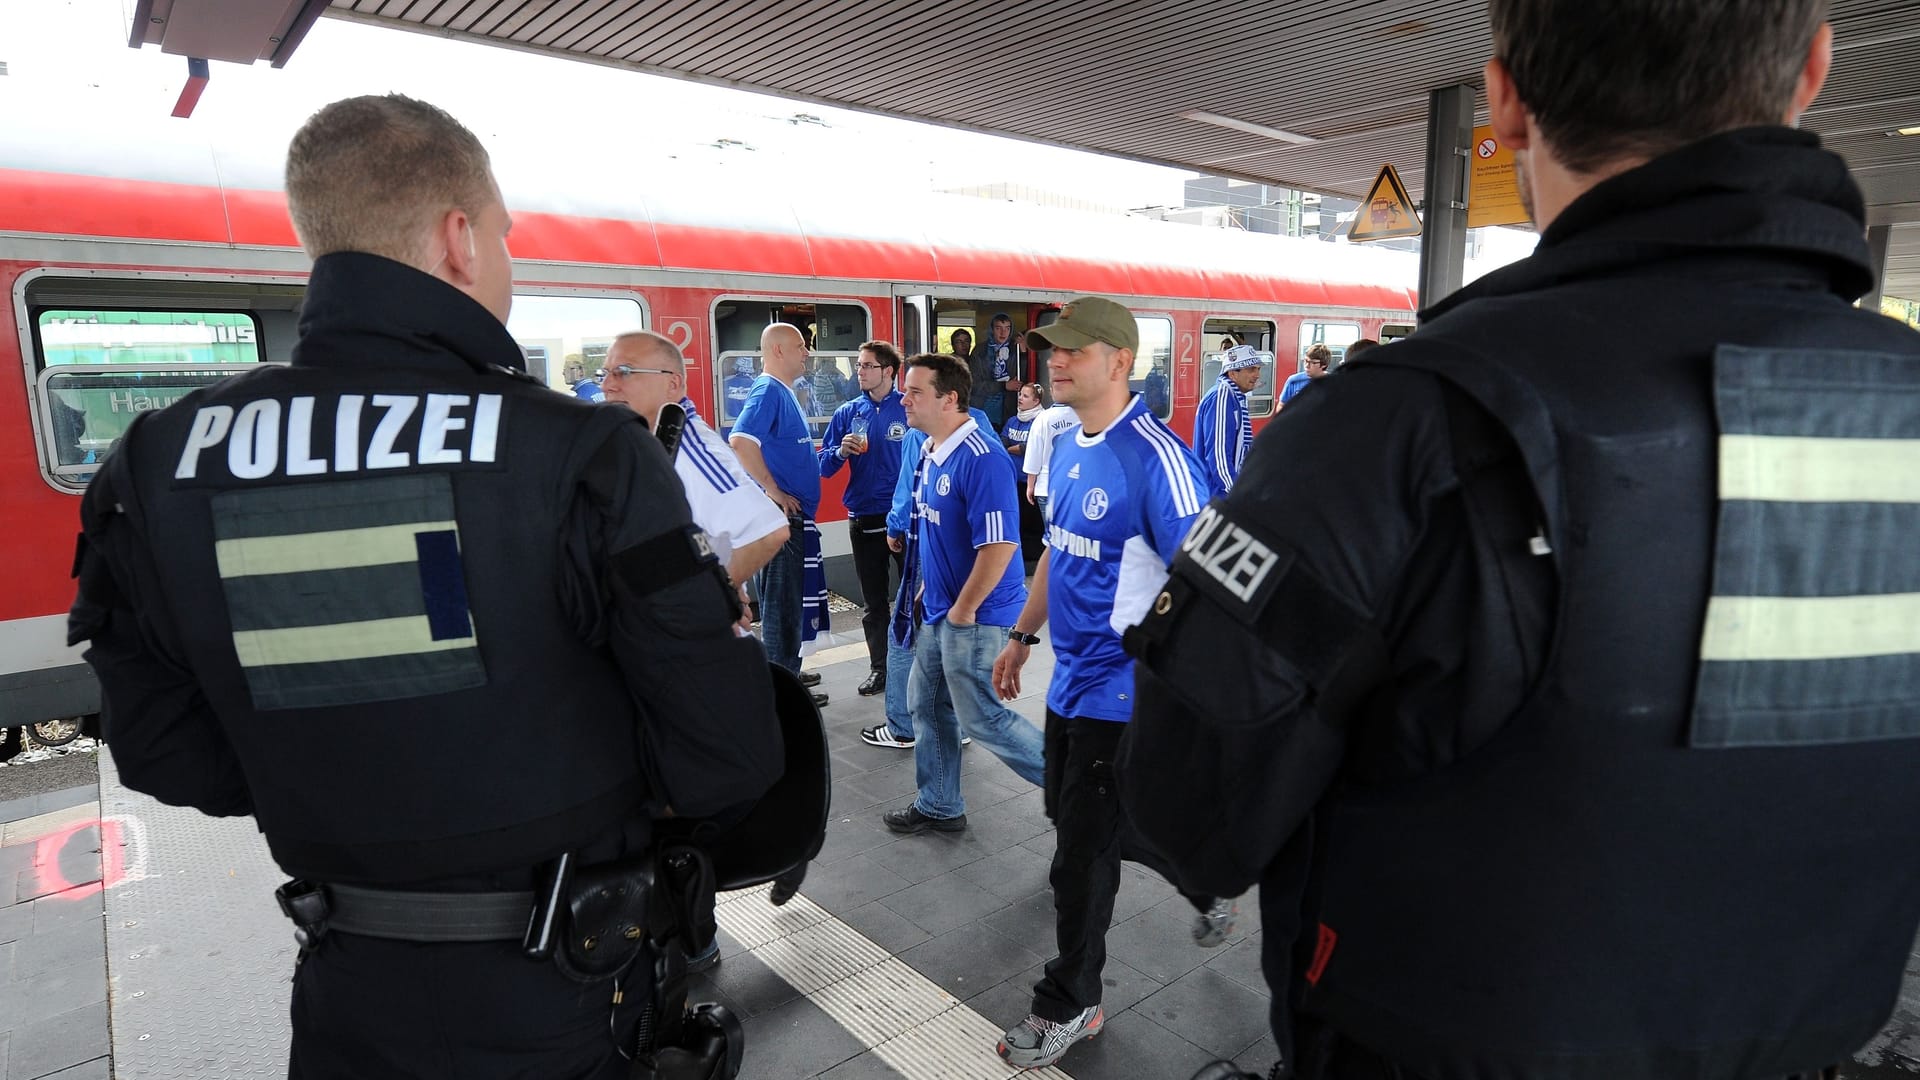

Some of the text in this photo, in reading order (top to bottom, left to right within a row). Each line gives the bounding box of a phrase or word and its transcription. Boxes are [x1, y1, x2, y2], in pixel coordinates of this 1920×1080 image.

[668, 321, 695, 365] 2
[1181, 333, 1193, 362] 2
[174, 393, 502, 479] POLIZEI
[1182, 505, 1280, 603] OLIZEI
